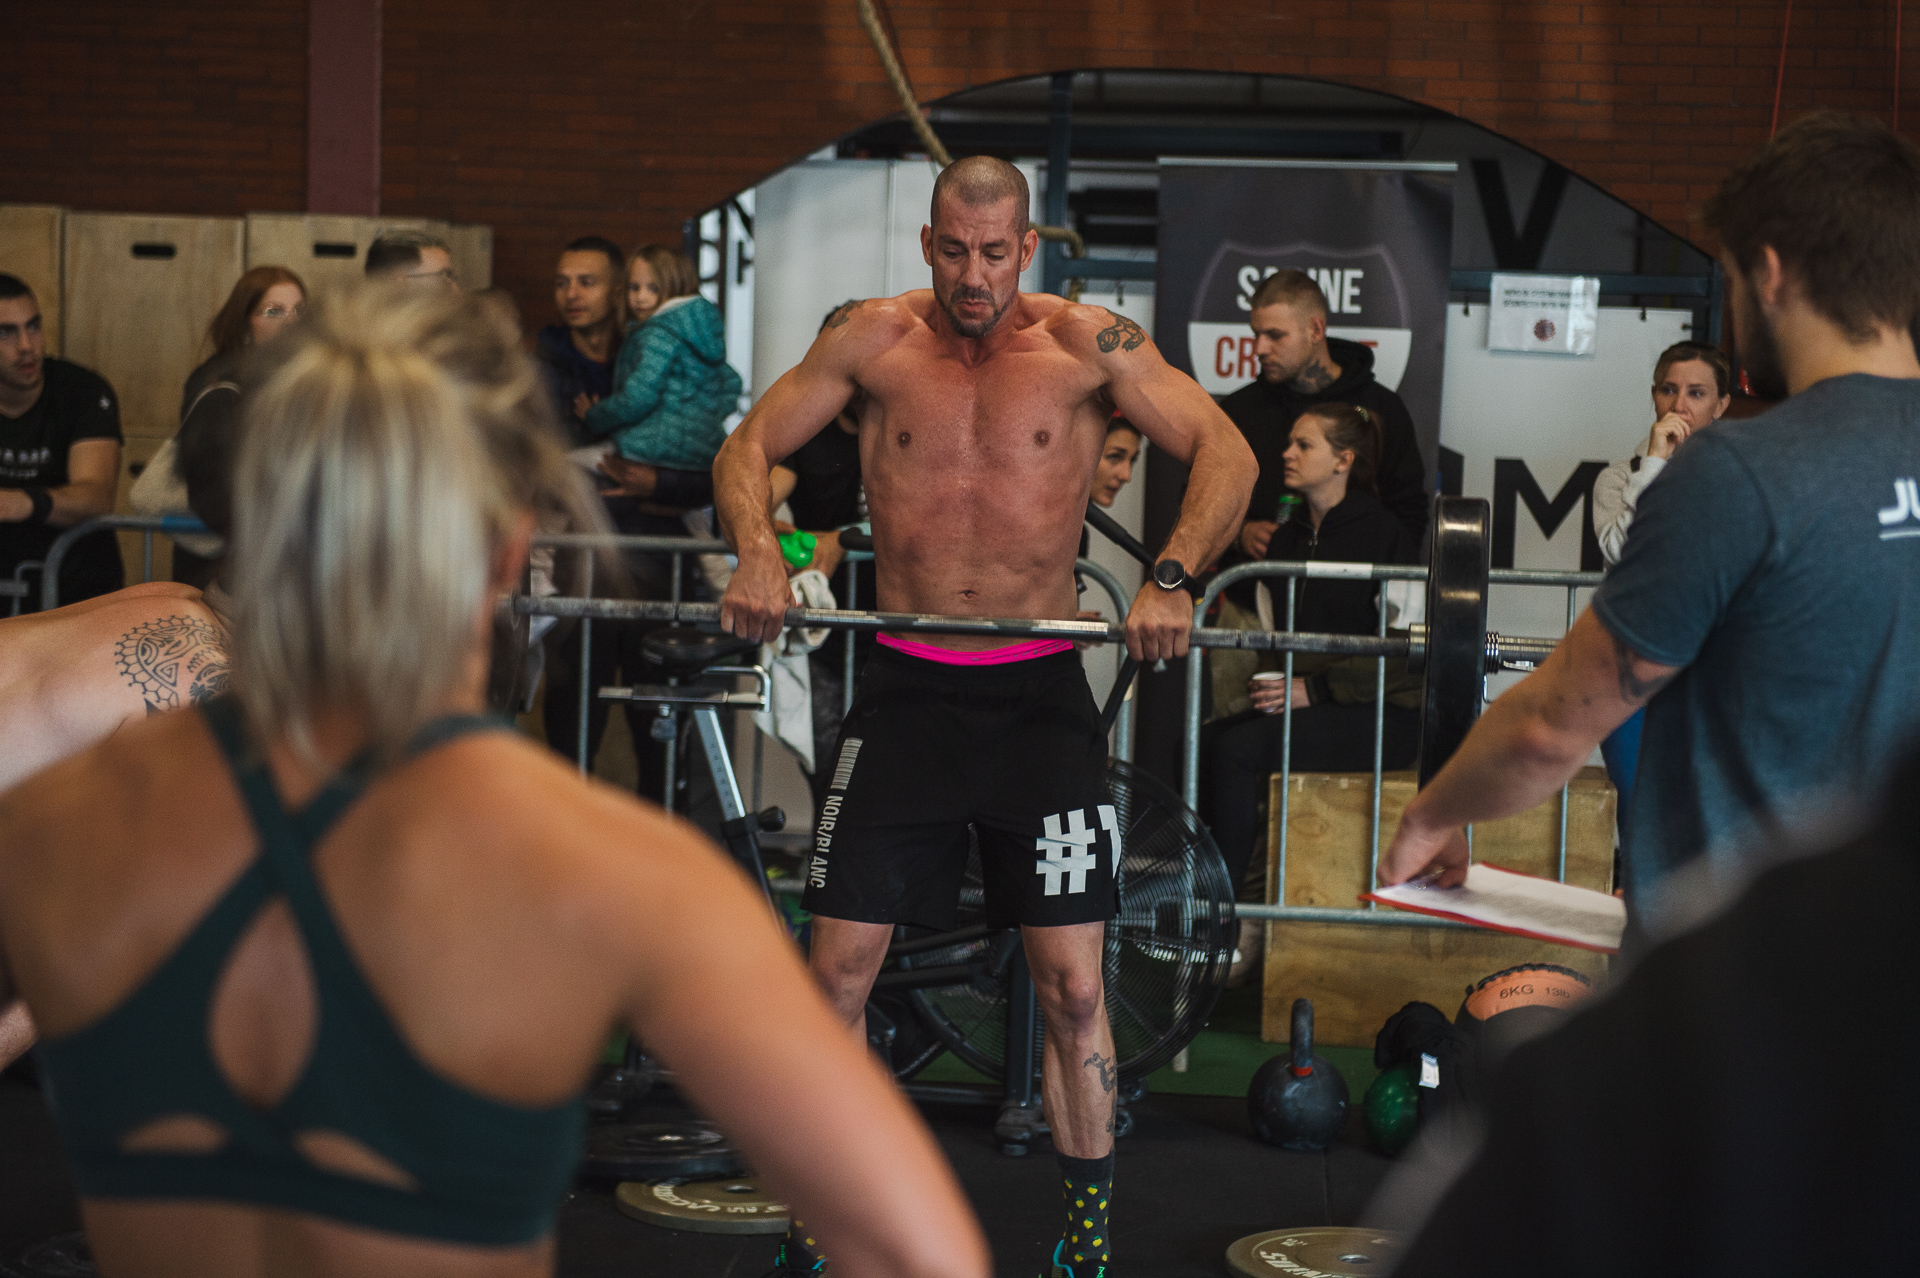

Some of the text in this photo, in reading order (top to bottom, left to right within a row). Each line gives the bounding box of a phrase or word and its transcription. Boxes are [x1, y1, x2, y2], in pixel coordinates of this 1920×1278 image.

[1236, 264, 1364, 314] SNE
[1499, 983, 1571, 1000] 6KG 13lb
